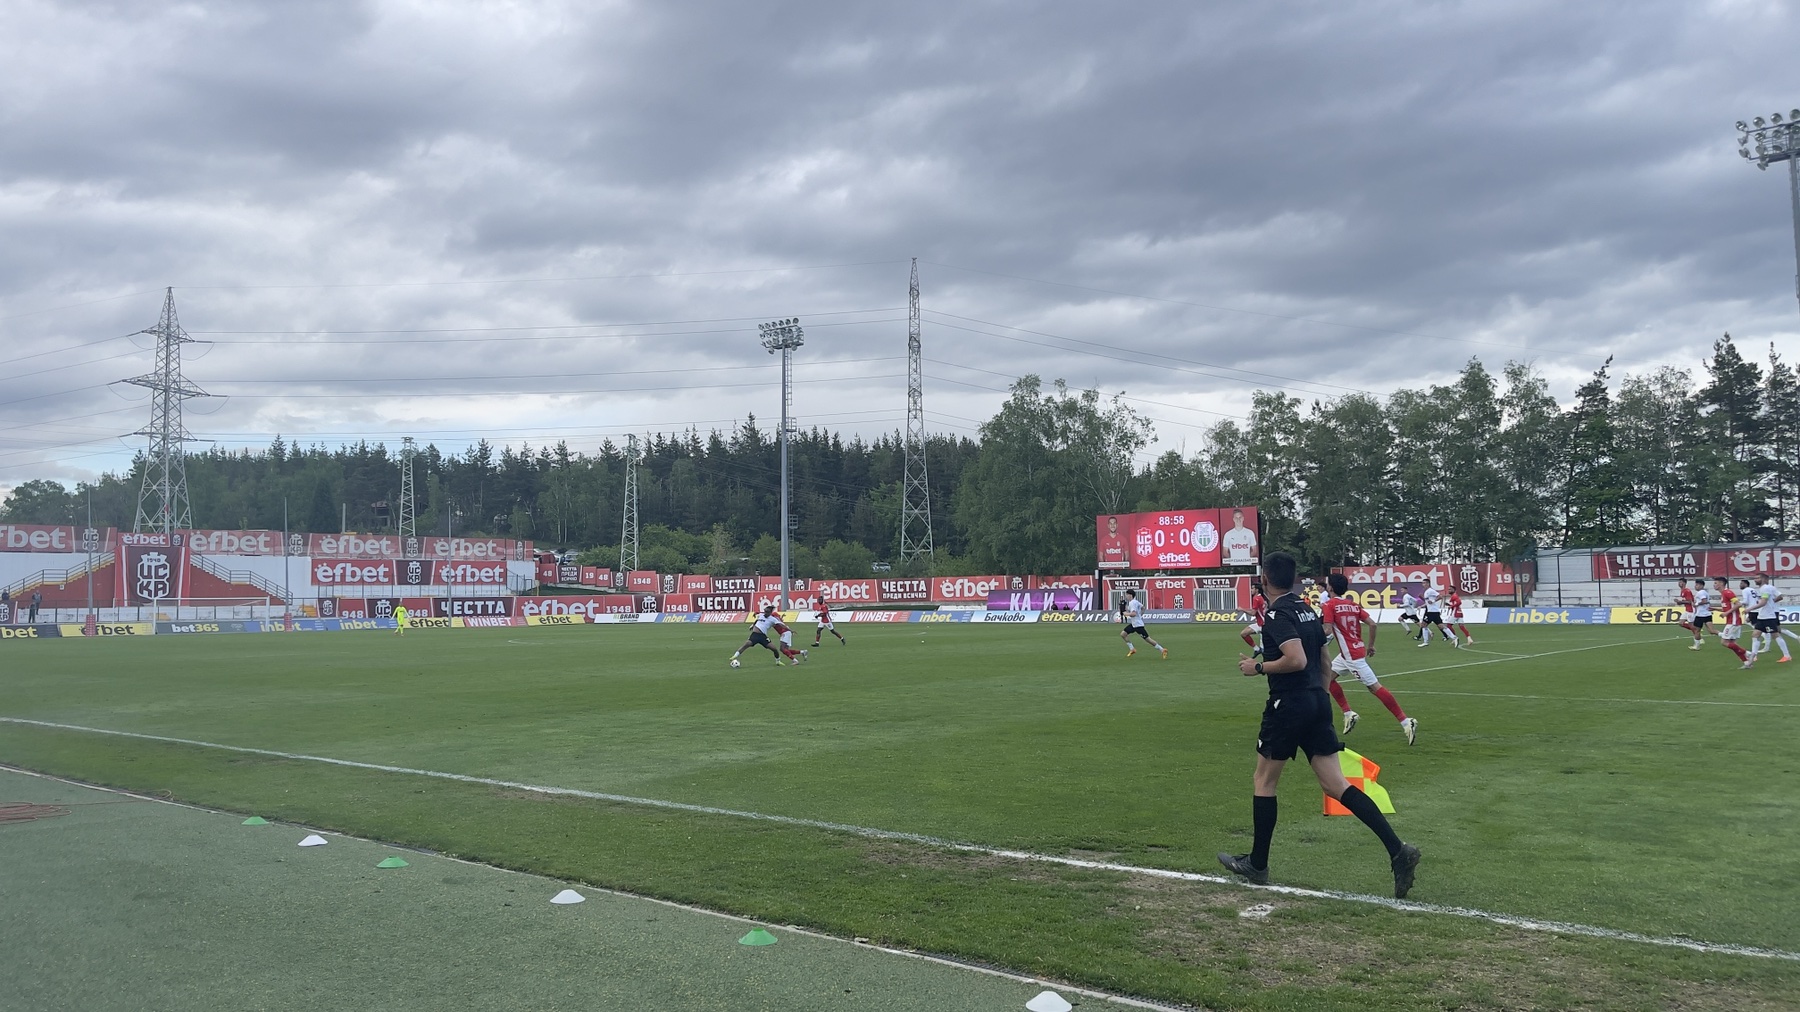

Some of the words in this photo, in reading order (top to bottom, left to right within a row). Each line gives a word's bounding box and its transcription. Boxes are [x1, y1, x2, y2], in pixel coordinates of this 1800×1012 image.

[1158, 515, 1185, 526] 88:58
[1154, 529, 1165, 547] 0
[1179, 528, 1191, 546] 0
[1616, 553, 1696, 568] ЧЕСТТА
[1732, 549, 1800, 571] efb
[315, 562, 389, 583] efbet
[440, 564, 504, 583] efbet
[1654, 567, 1696, 575] ВСИЧКО
[715, 579, 755, 590] ЧЕСТТА
[881, 580, 927, 592] ЧЕСТТА
[1155, 580, 1186, 589] efbet
[440, 600, 506, 615] ЧЕСТТА
[666, 604, 688, 612] 1948
[697, 597, 746, 610] ЧЕСТТА
[466, 617, 512, 628] WINBET
[702, 613, 738, 622] WINBET
[855, 612, 897, 622] WINBET
[171, 623, 220, 633] bet365
[259, 621, 302, 632] inbt
